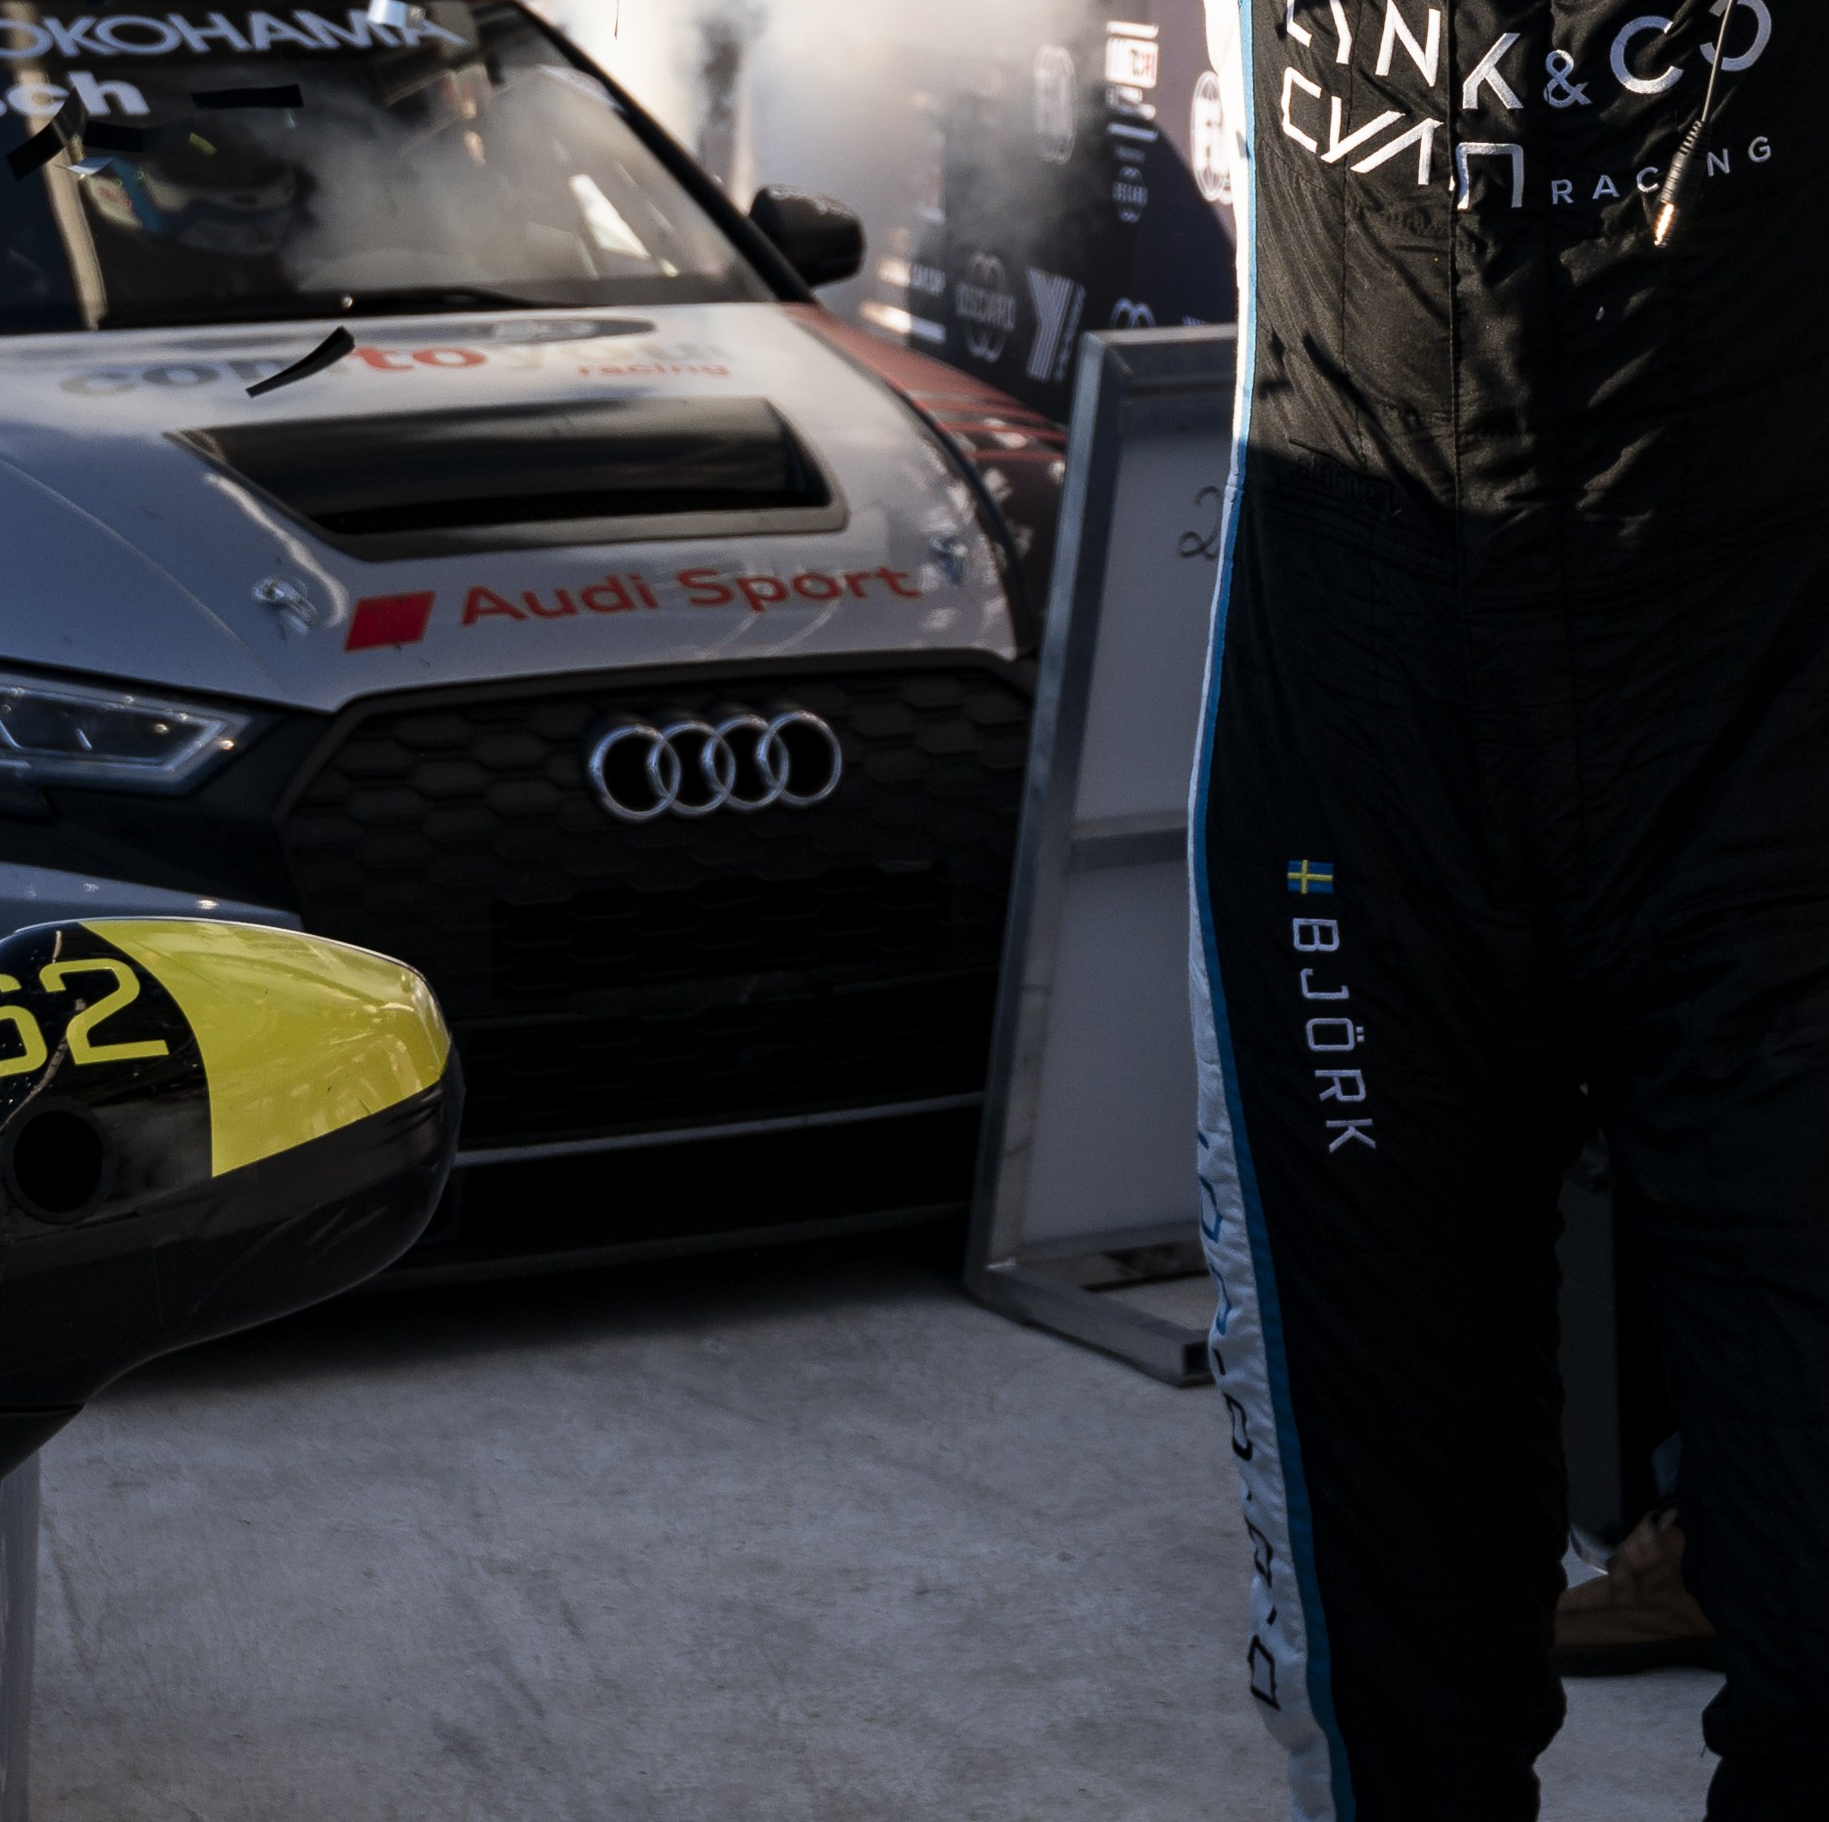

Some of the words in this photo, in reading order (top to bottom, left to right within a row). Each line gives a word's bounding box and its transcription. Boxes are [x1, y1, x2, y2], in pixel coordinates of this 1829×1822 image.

[1550, 134, 1774, 207] RACNG
[461, 572, 660, 628] Audi
[678, 565, 924, 613] Sport
[1292, 917, 1377, 1155] BJÖRK
